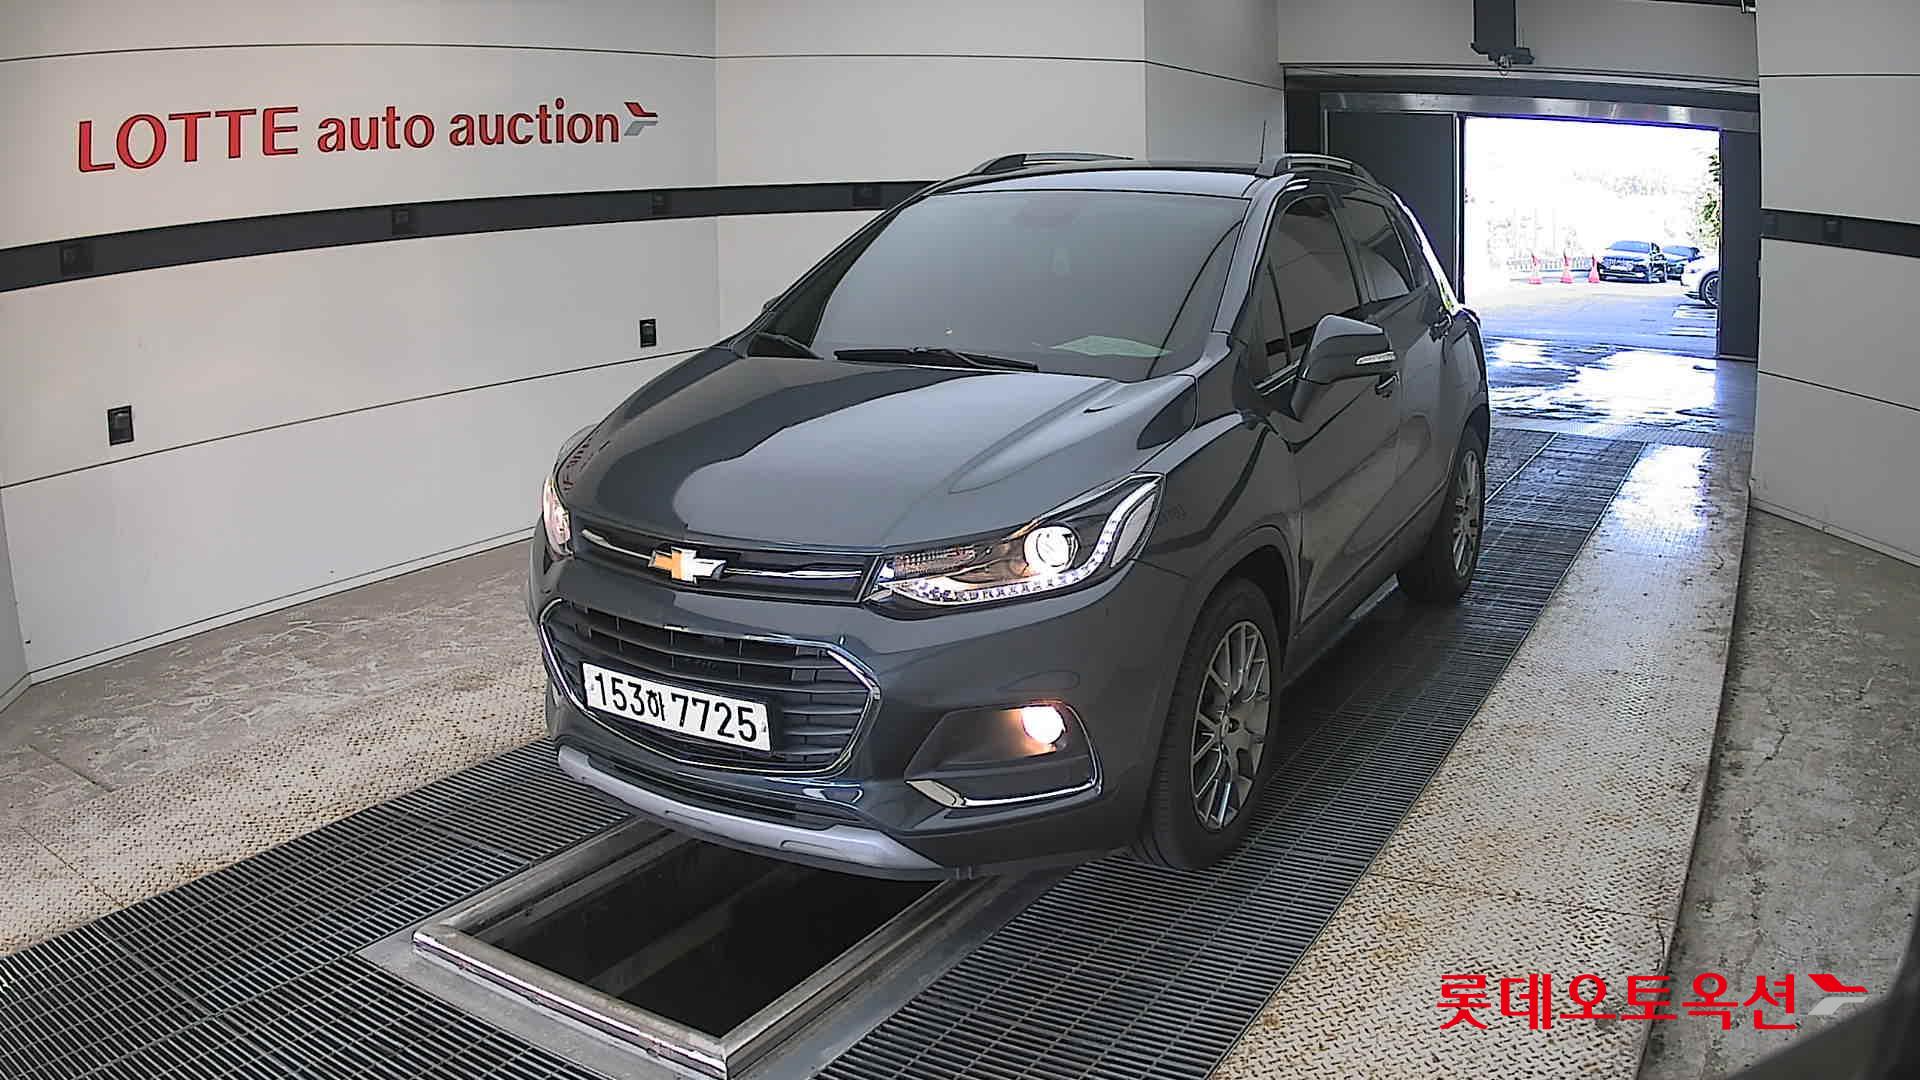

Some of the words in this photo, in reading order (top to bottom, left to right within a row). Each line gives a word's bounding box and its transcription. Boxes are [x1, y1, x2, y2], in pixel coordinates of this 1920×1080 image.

[77, 105, 299, 173] LOTTE
[317, 105, 435, 154] auto
[449, 98, 620, 146] auction
